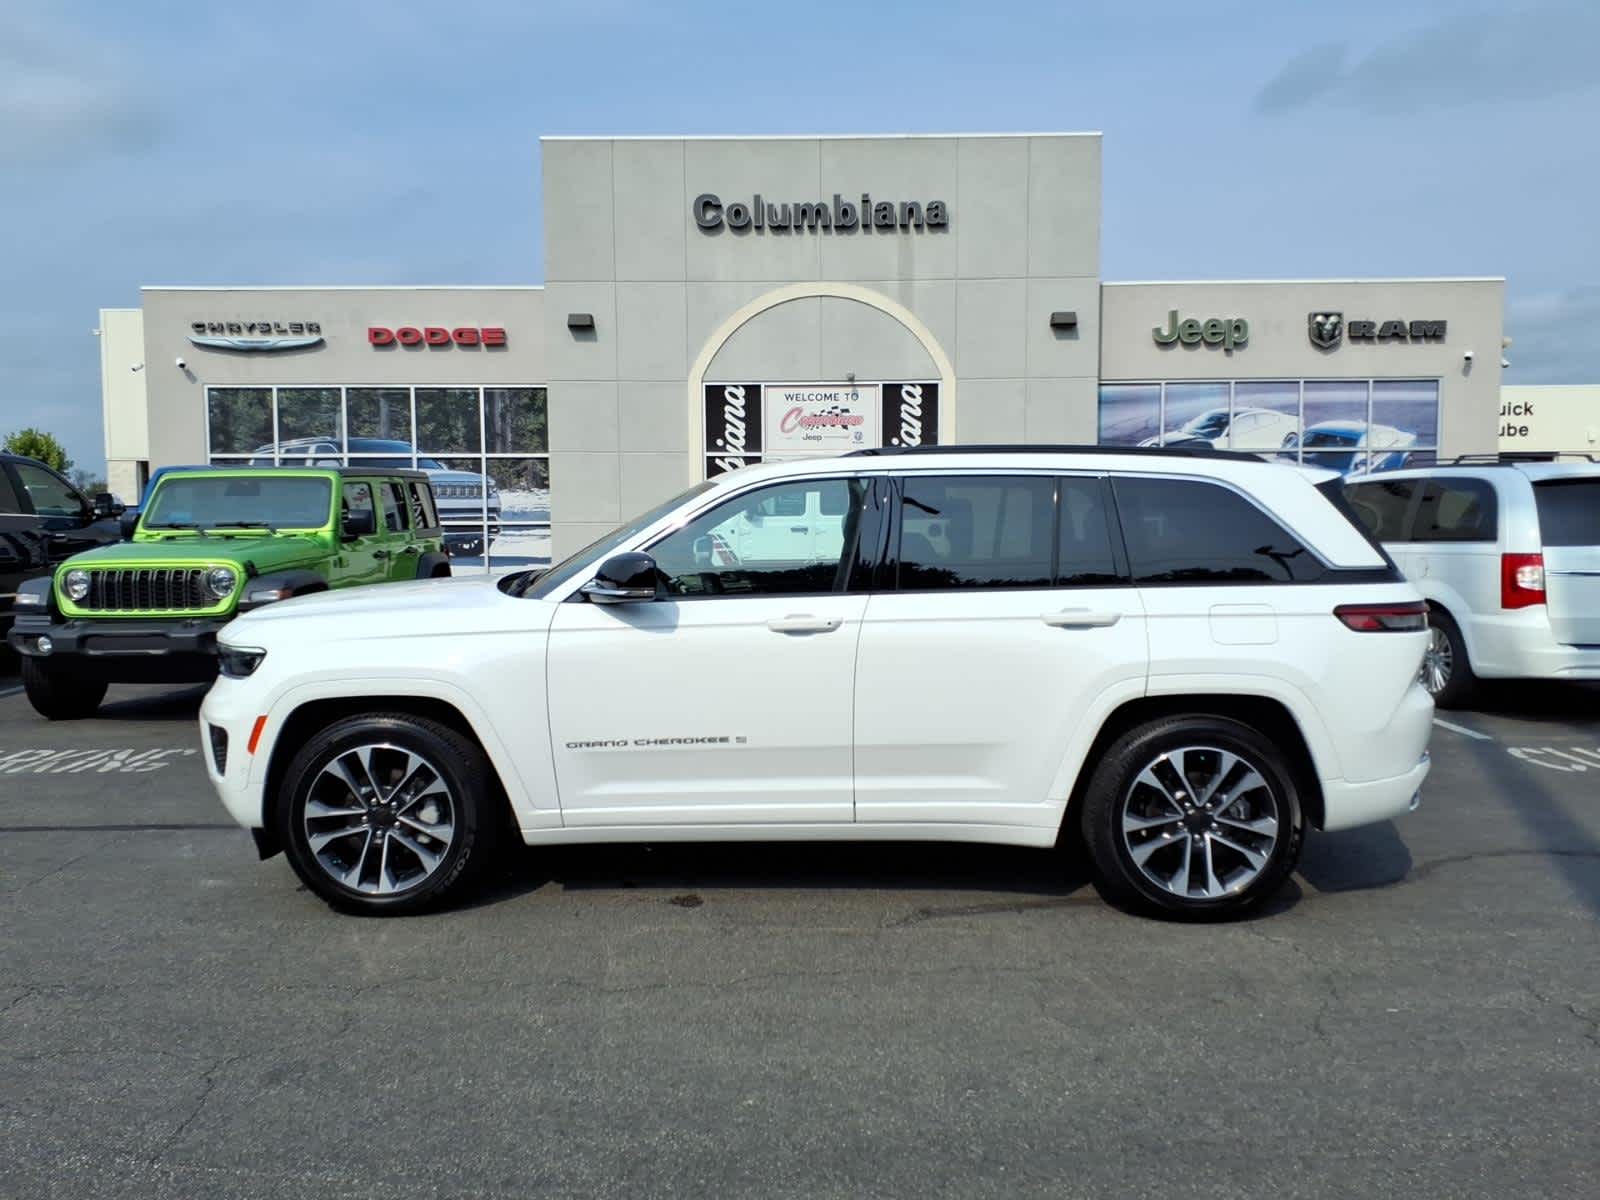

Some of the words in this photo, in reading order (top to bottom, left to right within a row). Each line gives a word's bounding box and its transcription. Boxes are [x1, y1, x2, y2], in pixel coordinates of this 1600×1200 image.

[693, 193, 949, 229] Columbiana
[192, 322, 321, 334] CHRYSLER
[368, 327, 506, 345] DODGE
[1152, 309, 1249, 352] Jeep
[1349, 320, 1447, 340] RAM
[785, 392, 840, 402] WELCOME
[845, 392, 859, 402] TO
[565, 740, 628, 749] GRAND
[634, 736, 730, 746] CHEROKEE
